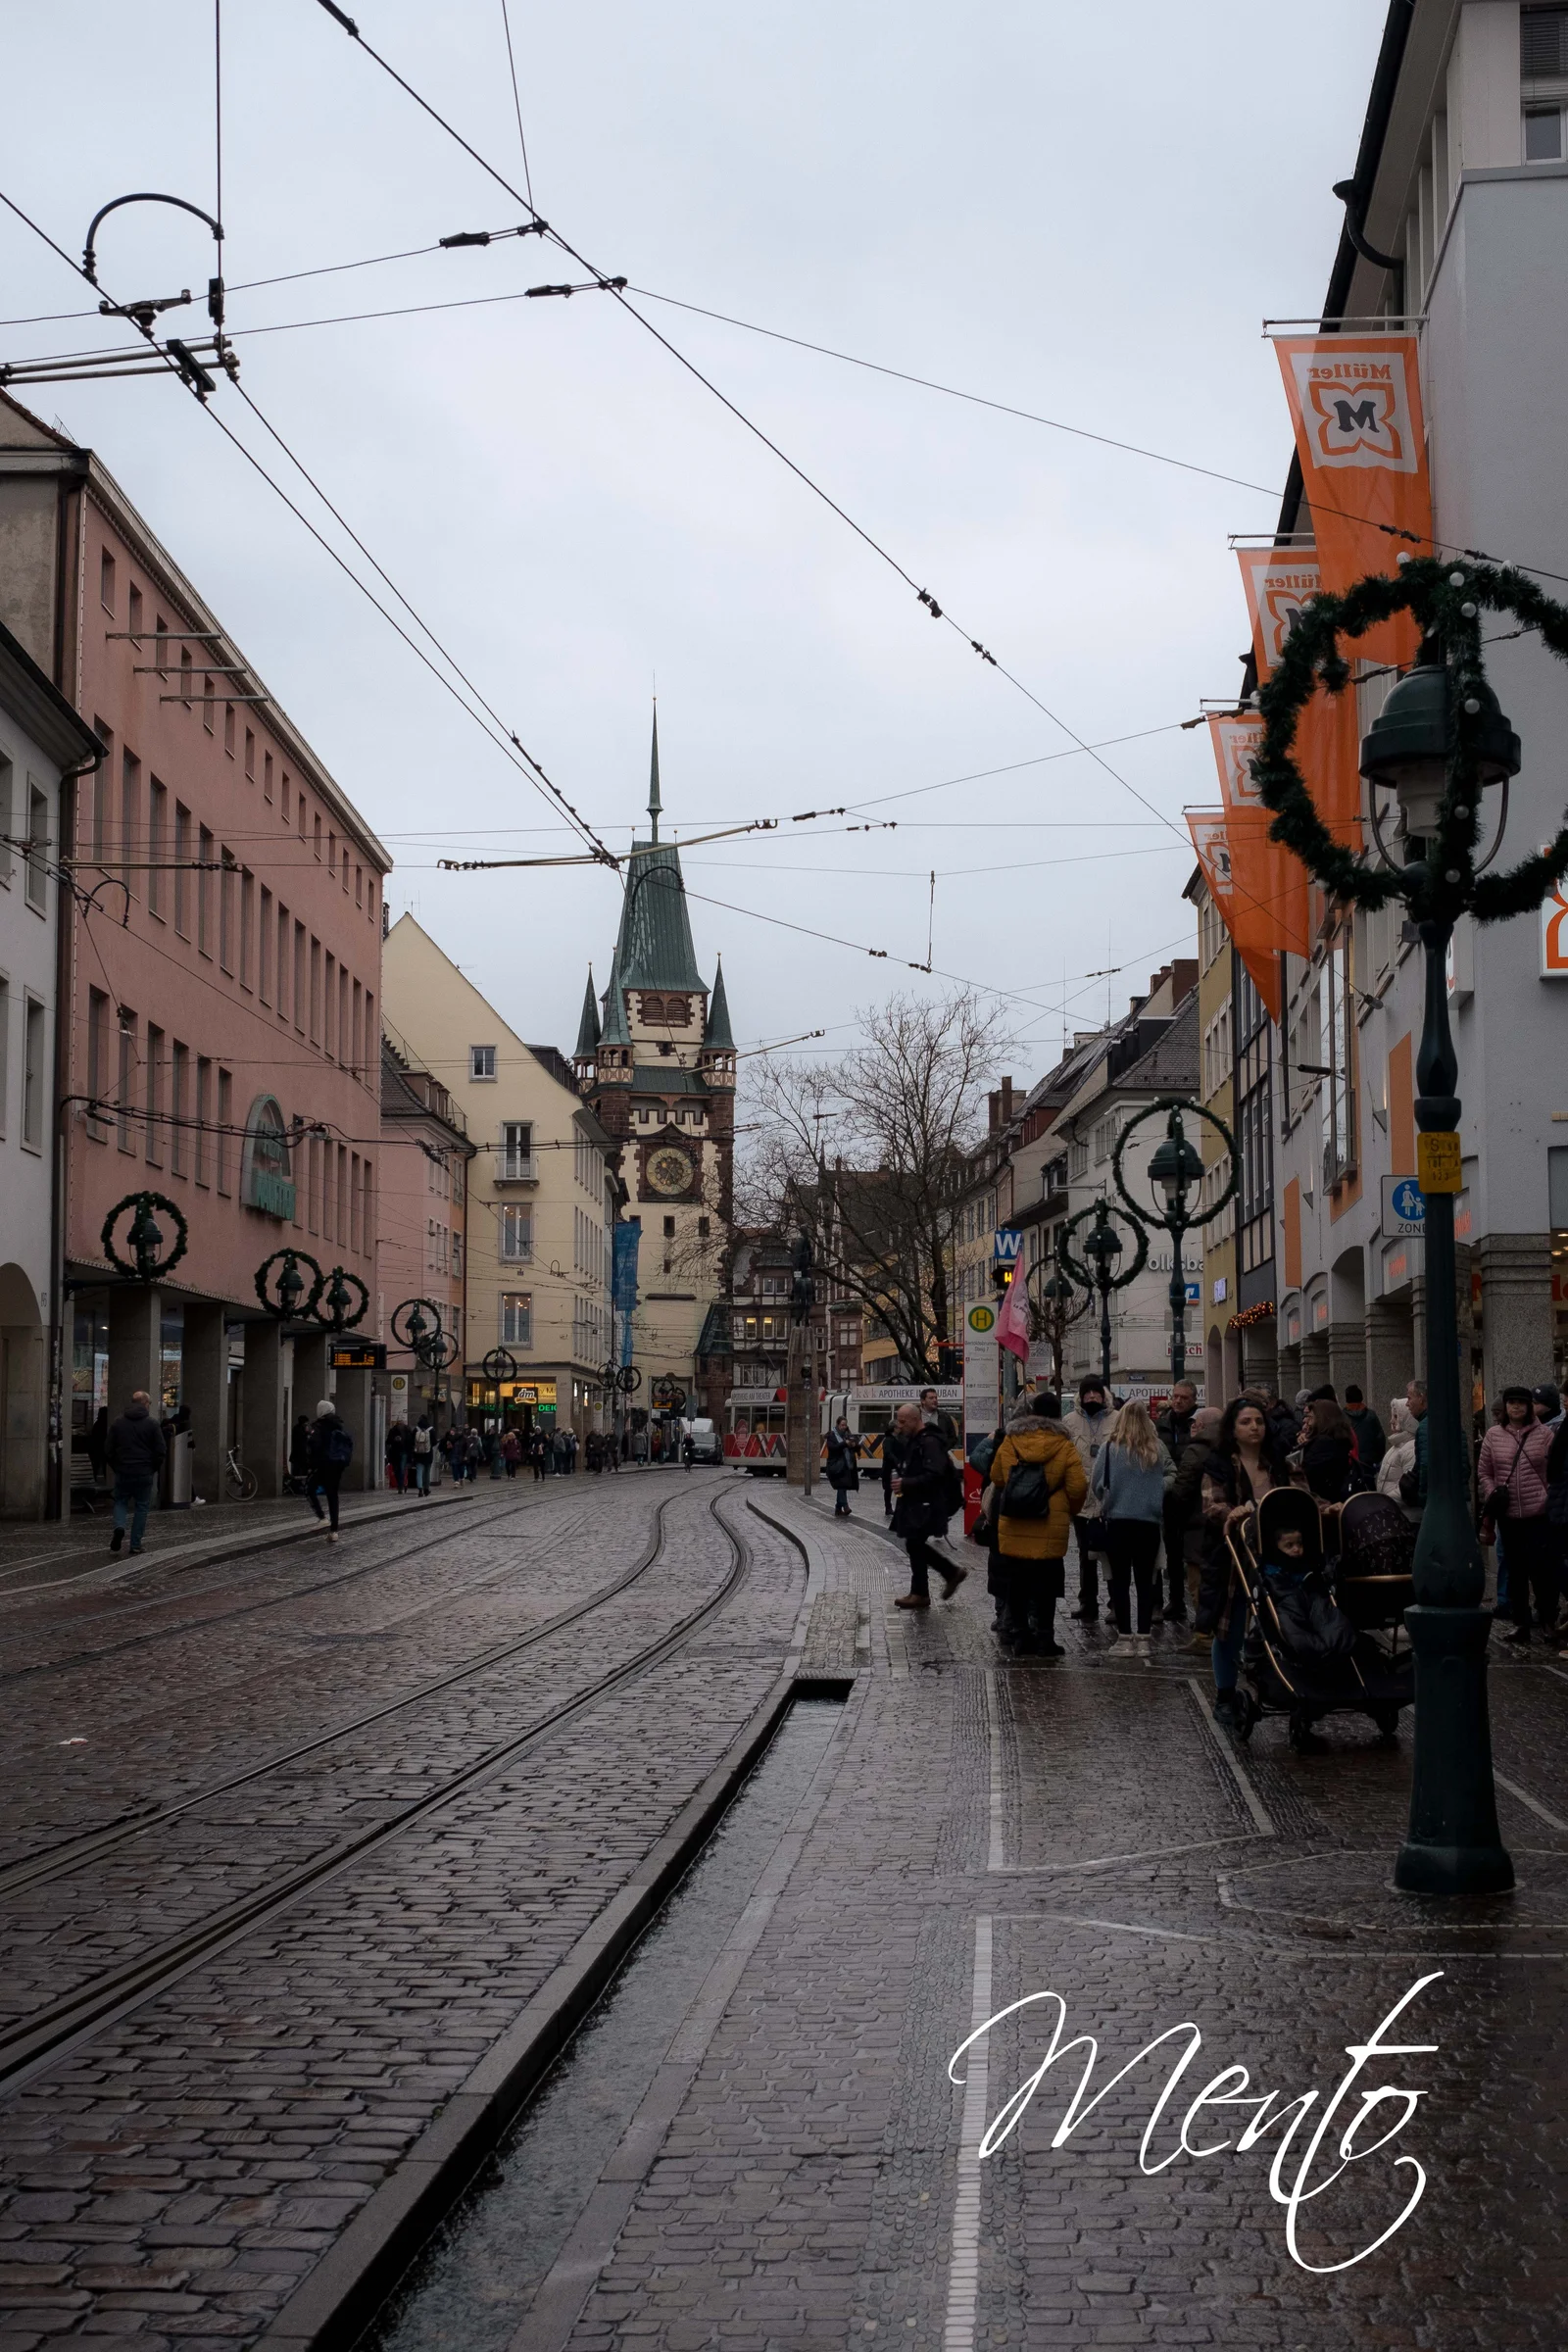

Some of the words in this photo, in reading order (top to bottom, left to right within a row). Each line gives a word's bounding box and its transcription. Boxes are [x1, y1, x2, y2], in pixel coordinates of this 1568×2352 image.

[996, 1233, 1022, 1256] W
[976, 1311, 987, 1327] H
[518, 1388, 536, 1398] dm
[879, 1389, 914, 1398] APOTHEKE
[938, 1389, 957, 1398] UBAN
[1129, 1388, 1173, 1397] APOTHEK
